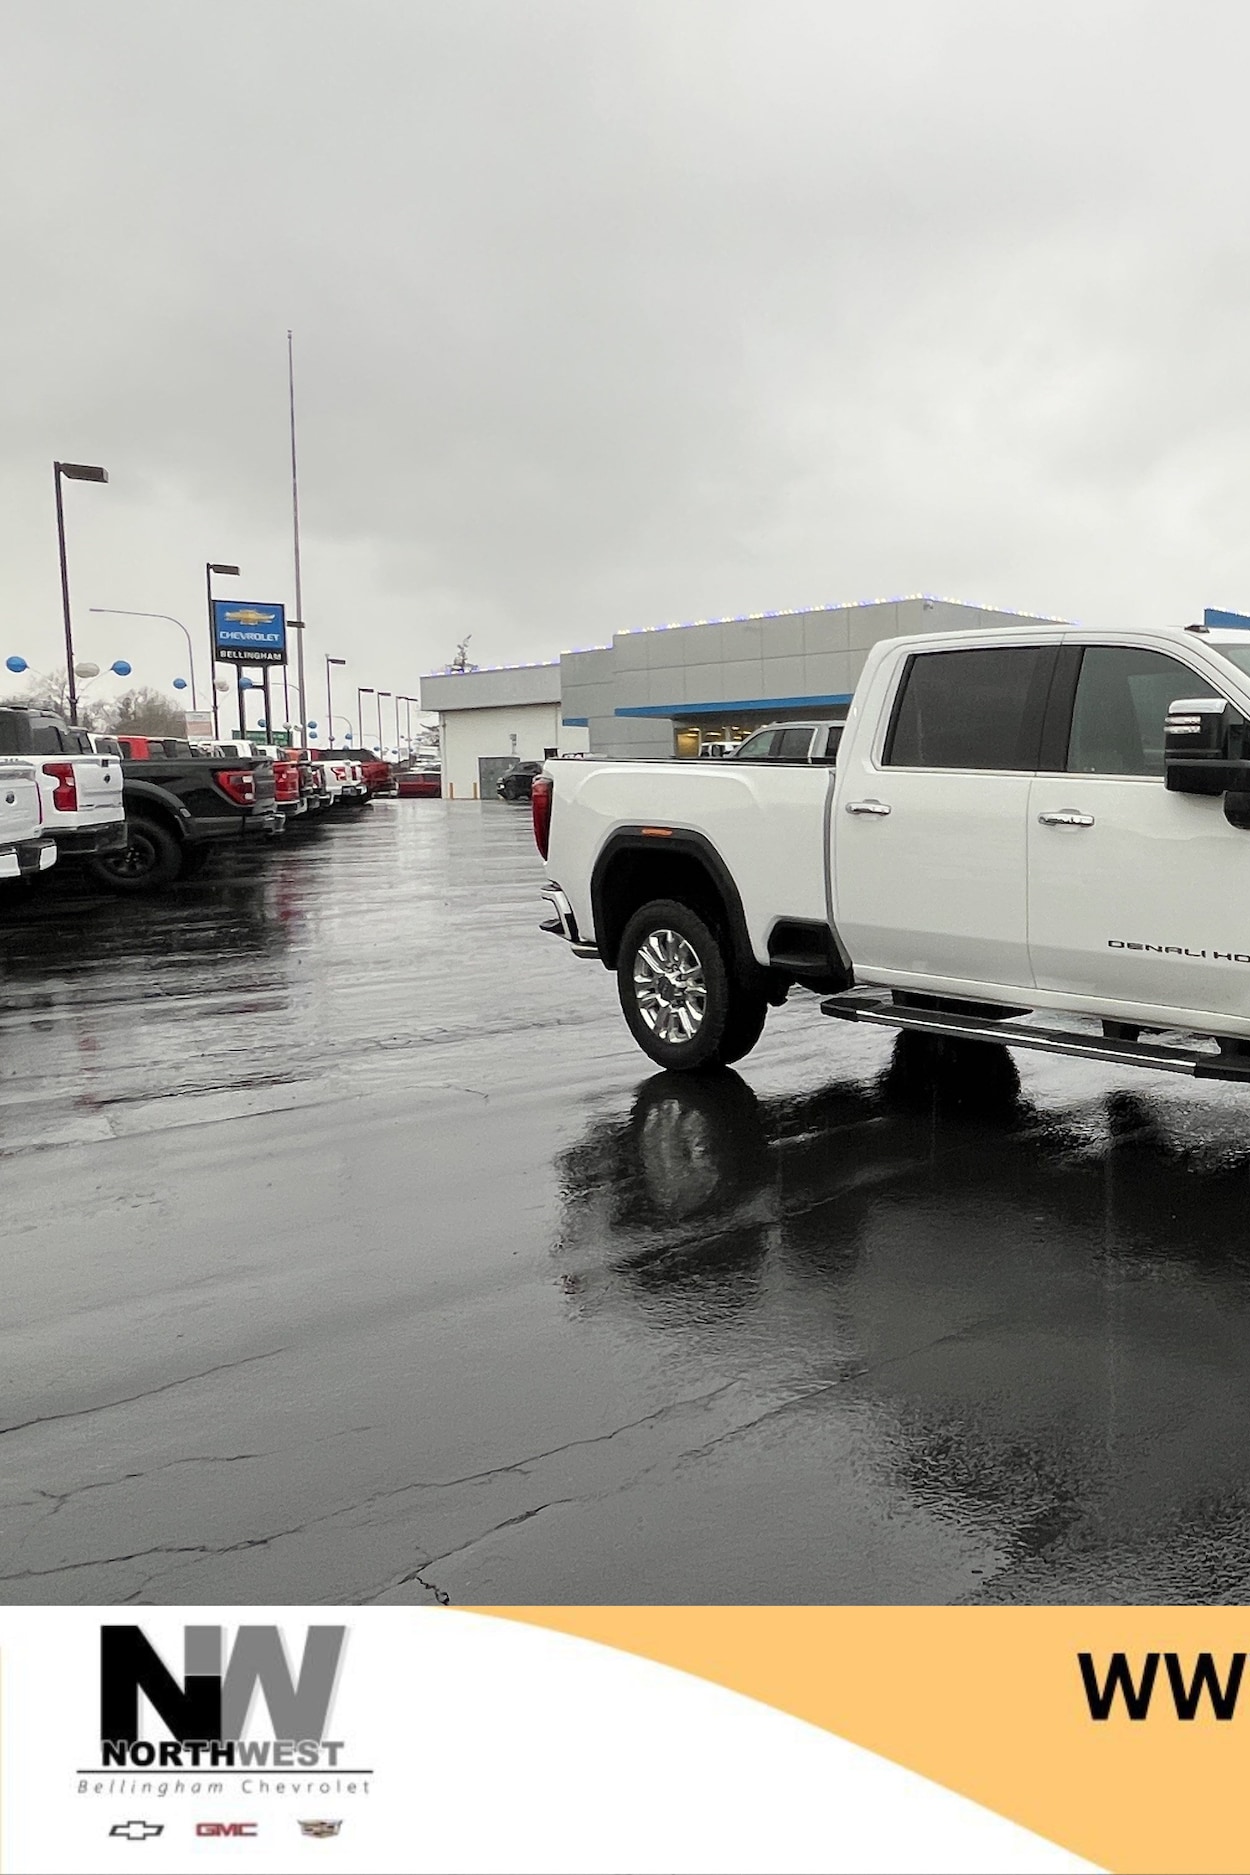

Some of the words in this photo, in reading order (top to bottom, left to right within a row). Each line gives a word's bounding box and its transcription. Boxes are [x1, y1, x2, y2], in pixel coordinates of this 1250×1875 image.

[220, 631, 280, 641] CHEVROLET
[220, 650, 281, 660] BELLINGHAM
[1108, 940, 1206, 958] DENALI
